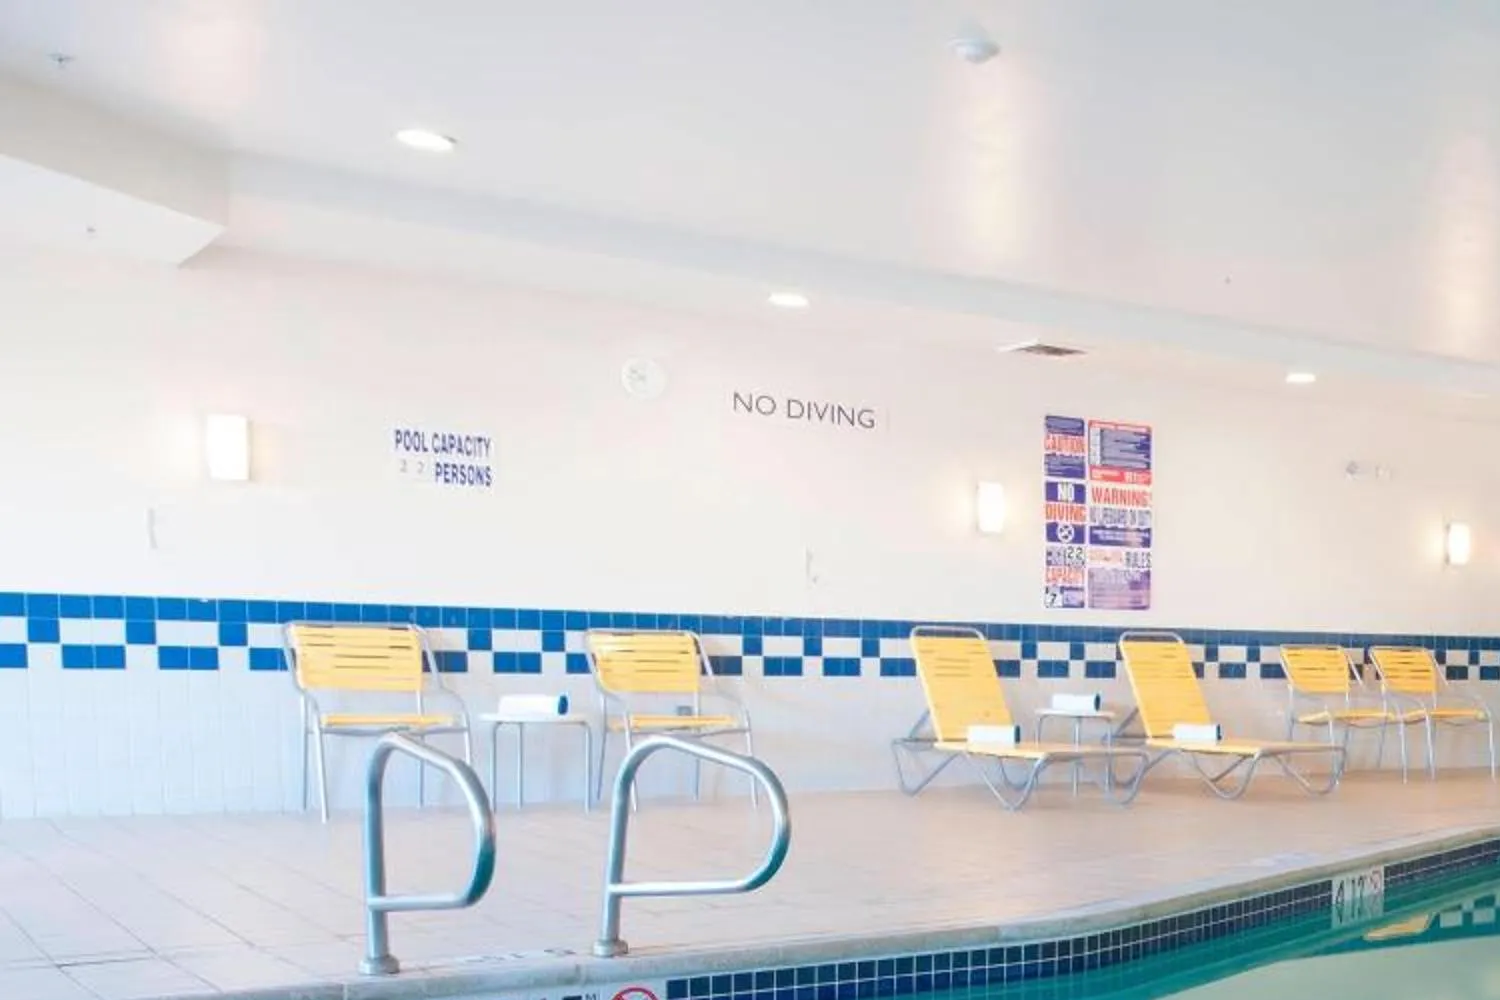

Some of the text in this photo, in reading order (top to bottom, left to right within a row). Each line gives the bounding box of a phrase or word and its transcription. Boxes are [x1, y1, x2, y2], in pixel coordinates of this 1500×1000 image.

[733, 391, 876, 429] NO DIVING
[395, 429, 492, 458] POOL CAPACITY
[435, 462, 492, 486] PERSONS
[1057, 481, 1074, 501] NO
[1045, 502, 1086, 523] DIVING
